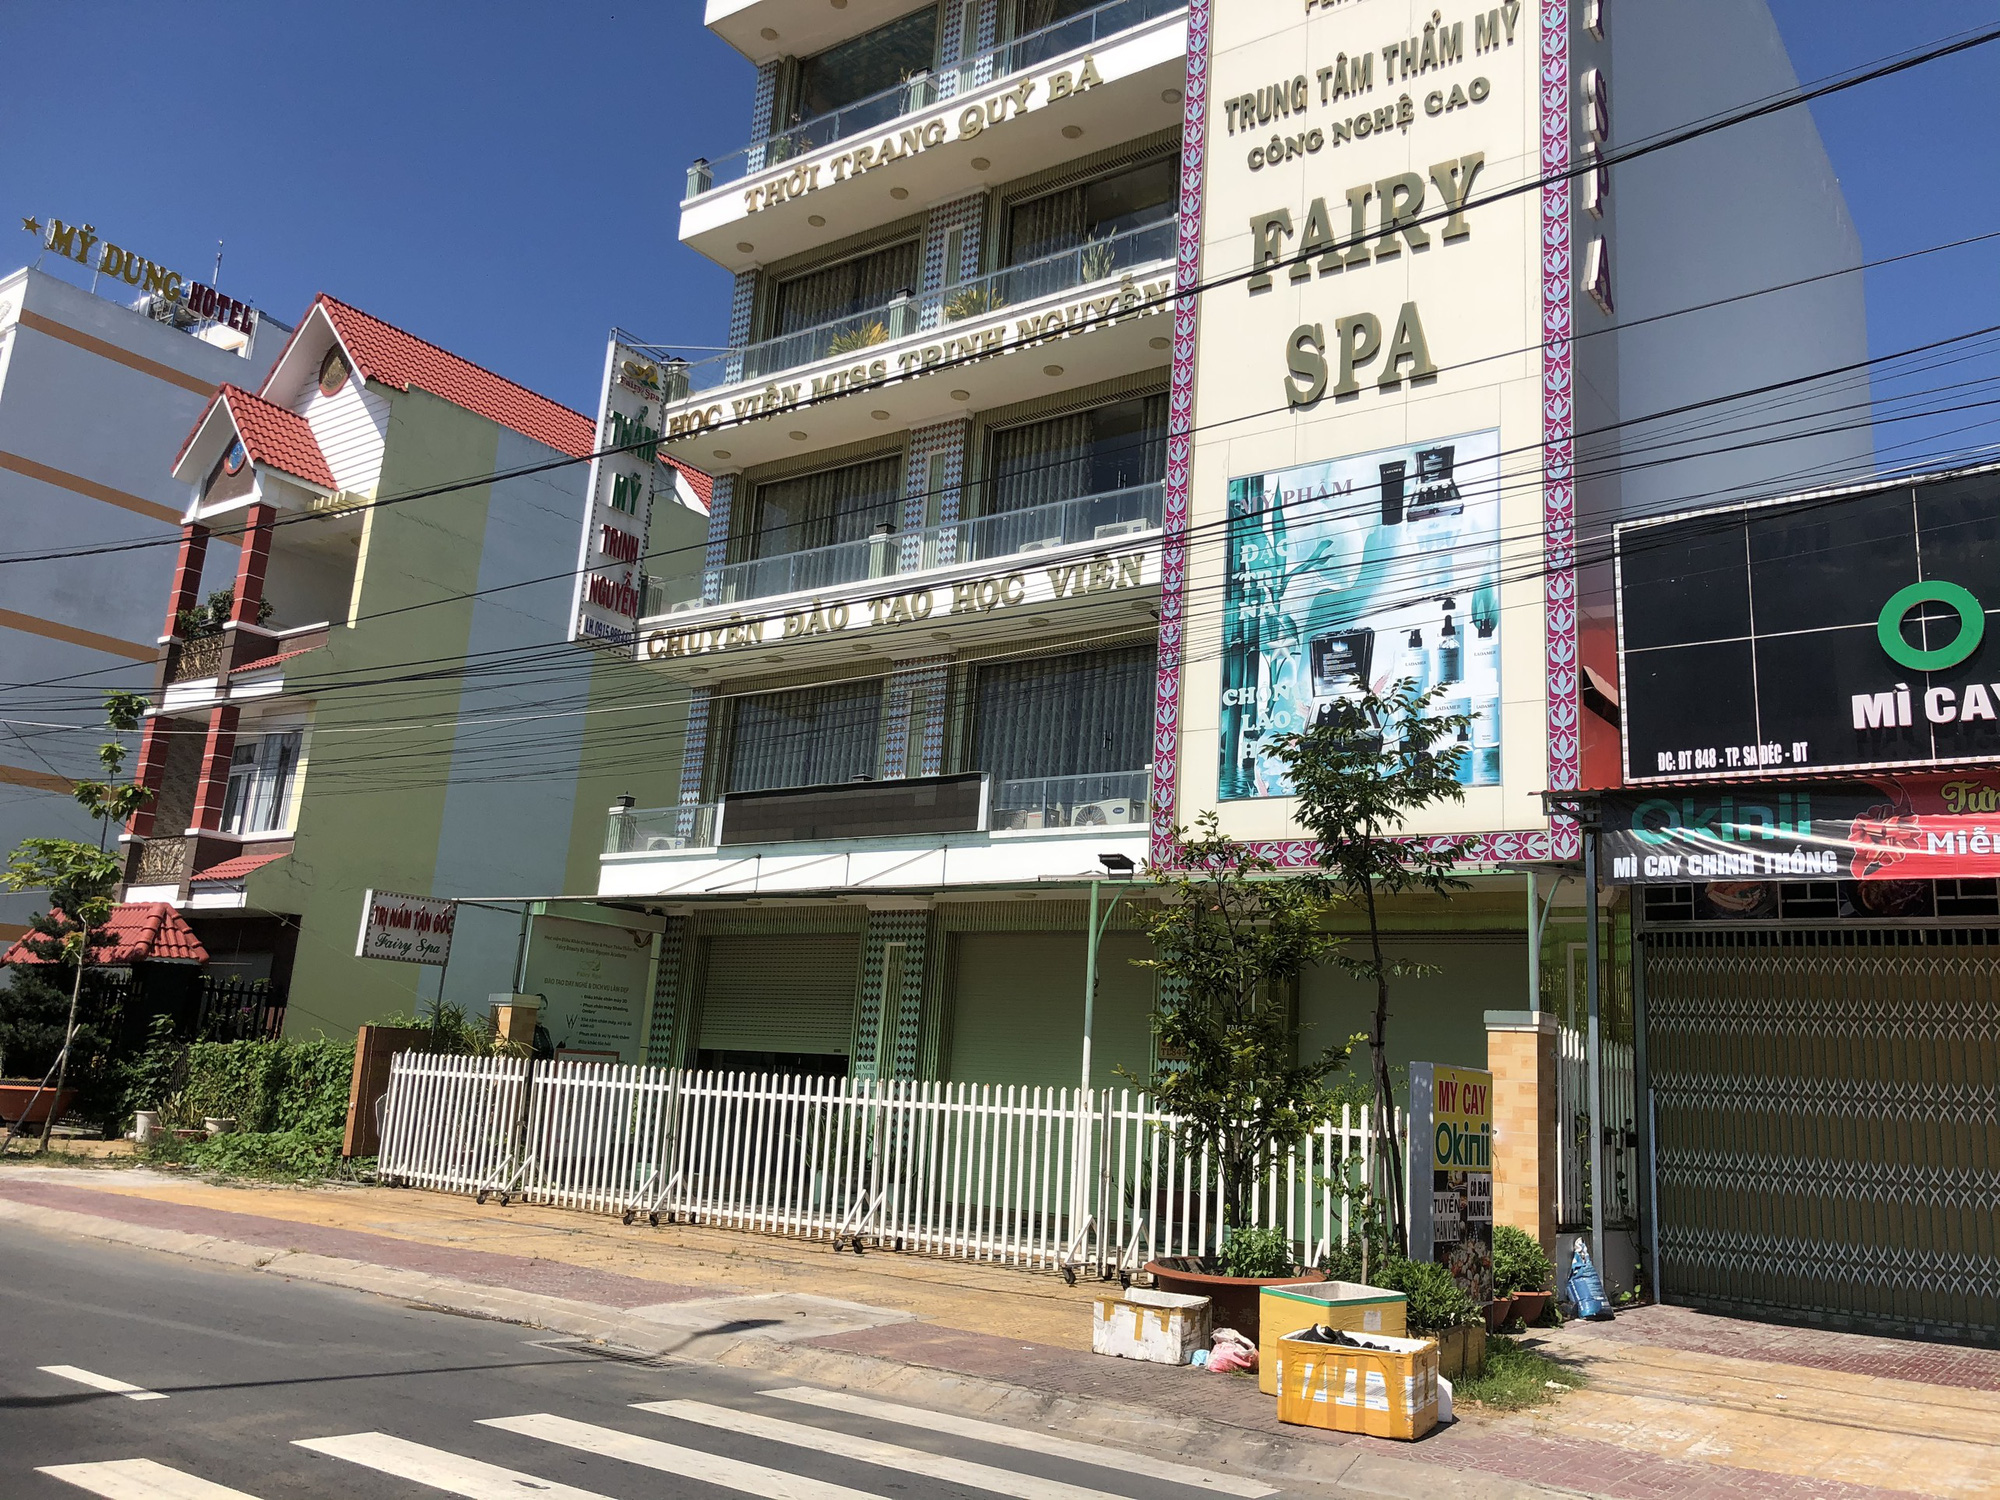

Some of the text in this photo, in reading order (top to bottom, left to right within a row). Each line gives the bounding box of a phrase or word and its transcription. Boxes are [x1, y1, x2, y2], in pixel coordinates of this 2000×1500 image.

[1223, 74, 1308, 135] TRUNG
[1316, 52, 1373, 105] TÂM
[1382, 9, 1463, 84] THẨM
[743, 164, 819, 213] THỜI
[831, 117, 947, 182] TRANG
[958, 78, 1036, 141] QUÝ
[1247, 76, 1491, 169] CÔNG NGHỆ CAO
[1247, 151, 1485, 291] FAIRY
[101, 241, 182, 302] DUNG
[188, 281, 254, 336] HOTEL
[669, 274, 1171, 440] HỌC VIỆN MISS TRINH NGUYỄN
[1284, 301, 1438, 410] SPA
[618, 375, 660, 402] Fairy Spa
[610, 406, 658, 464] THẨM
[609, 472, 642, 515] MỸ
[600, 524, 639, 565] TRINH
[585, 571, 639, 619] NGUYỄN
[647, 612, 767, 659] CHUYÊN
[782, 598, 850, 639] ĐÀO
[950, 571, 1025, 614] HỌC
[1435, 704, 1461, 712] LADAMER
[1852, 683, 1912, 729] MÌ
[1678, 751, 1692, 770] ĐT
[1695, 748, 1716, 769] 848
[1725, 747, 1741, 767] TP.
[1744, 746, 1758, 766] SA
[1792, 742, 1808, 762] ĐT
[1613, 844, 1837, 878] MÌ CAY CHÍNH THỐNG
[373, 905, 389, 931] TRỊ
[389, 902, 412, 929] NÁM
[433, 905, 454, 934] GỐC
[375, 932, 441, 957] Fairy Spa
[1438, 1072, 1487, 1115] MỲ CAY
[1435, 1121, 1490, 1166] Okinii
